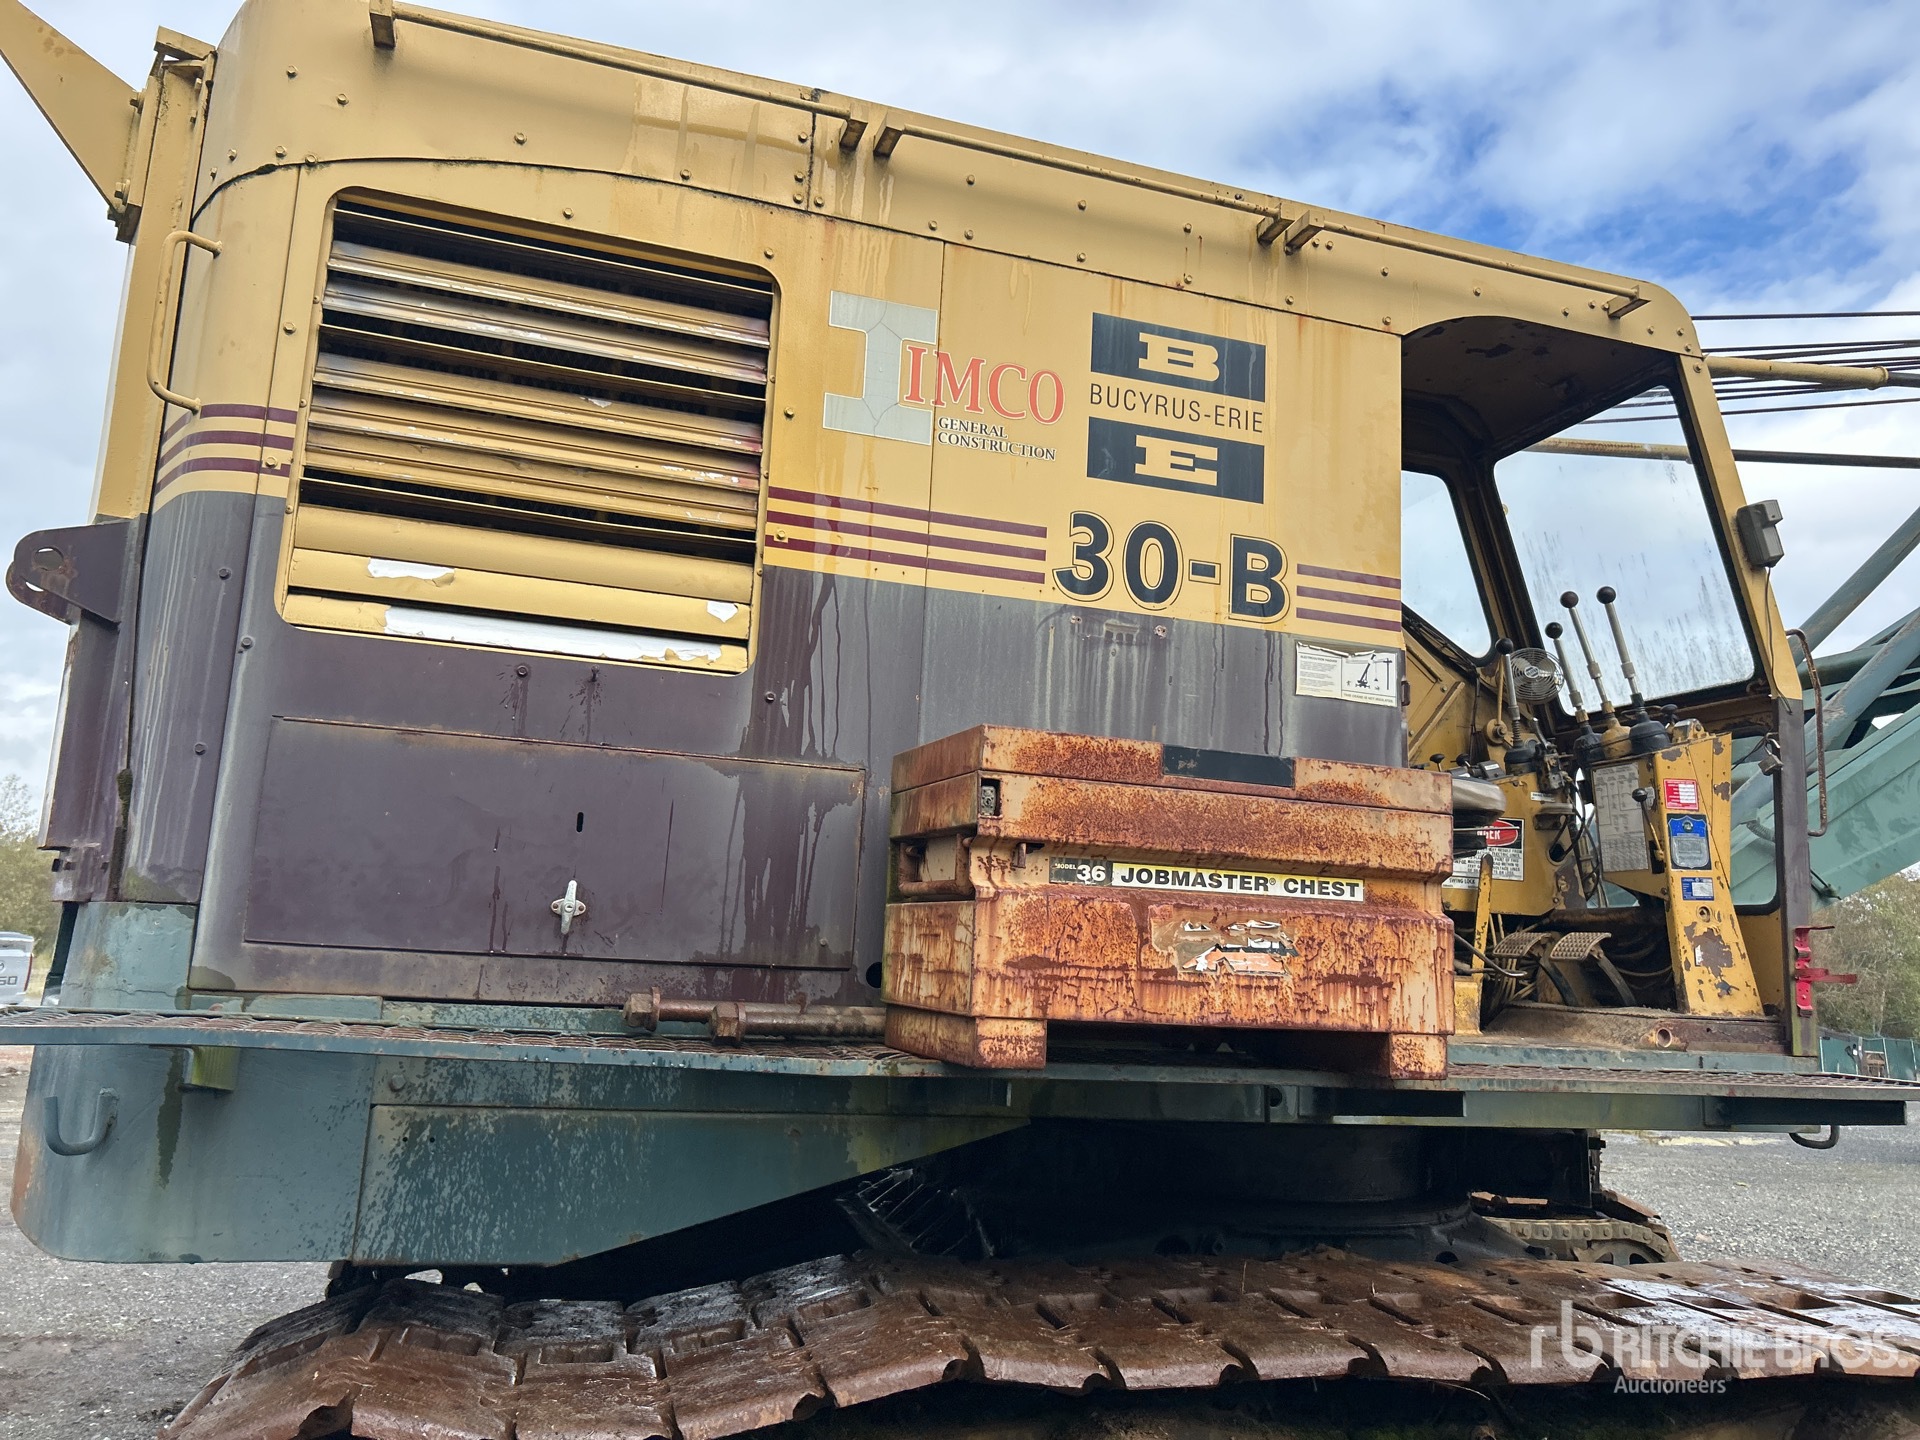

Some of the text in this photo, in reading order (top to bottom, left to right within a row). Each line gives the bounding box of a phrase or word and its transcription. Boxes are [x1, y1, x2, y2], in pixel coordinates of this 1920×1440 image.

[904, 345, 1065, 424] IMCO
[1090, 383, 1263, 433] BUCYRUS-ERIE
[938, 417, 1008, 439] GENERAL
[938, 432, 1057, 461] CONSTRUCTION
[1052, 510, 1291, 624] 30-B
[1054, 862, 1106, 883] MODEL 36
[1283, 878, 1360, 898] CHEST
